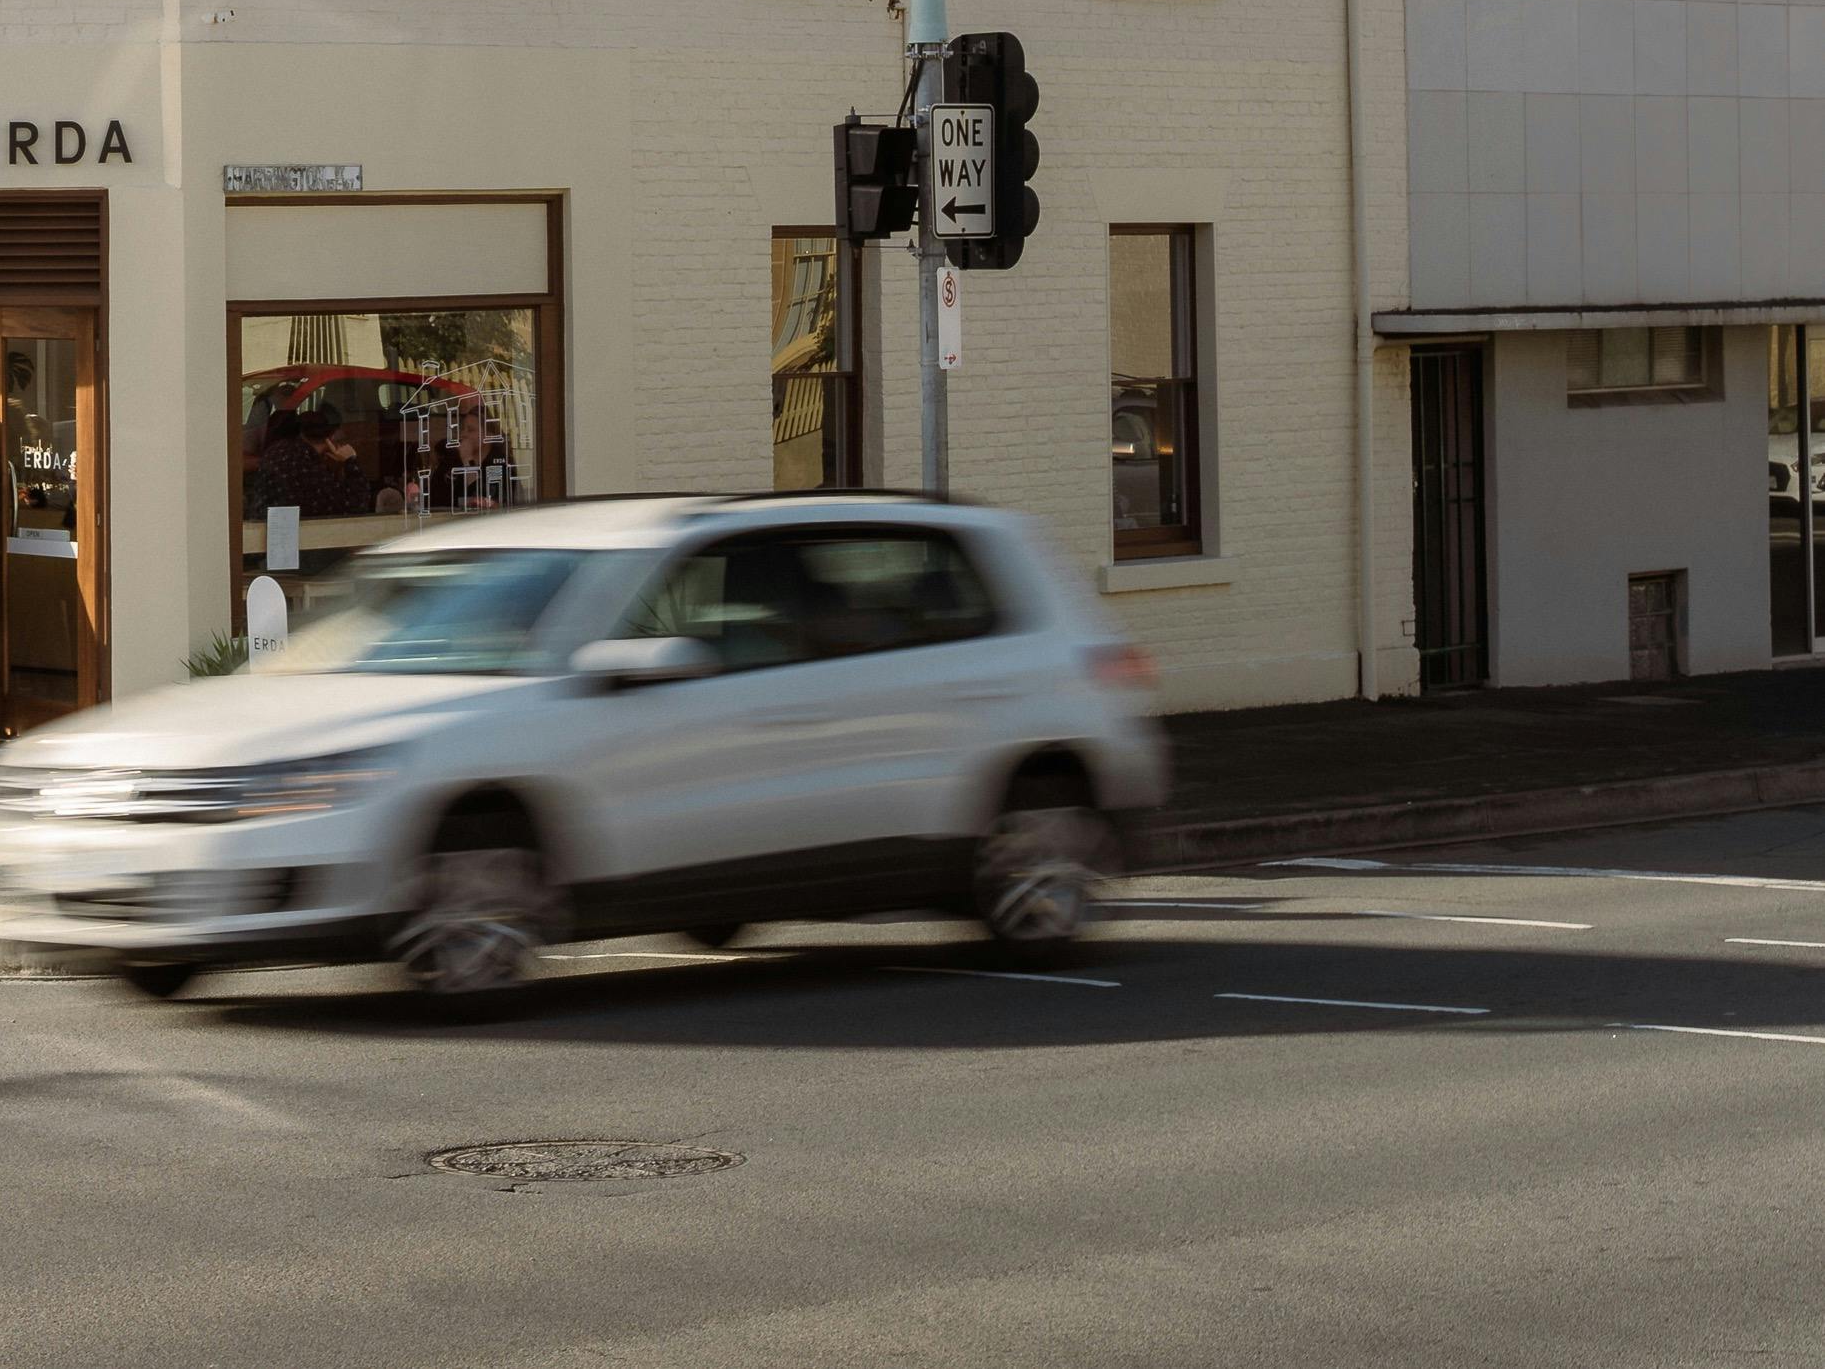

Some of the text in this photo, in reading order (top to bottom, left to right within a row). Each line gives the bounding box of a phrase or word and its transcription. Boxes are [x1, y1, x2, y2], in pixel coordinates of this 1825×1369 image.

[941, 118, 984, 147] ONE
[938, 159, 986, 187] WAY
[24, 451, 62, 469] ERDA
